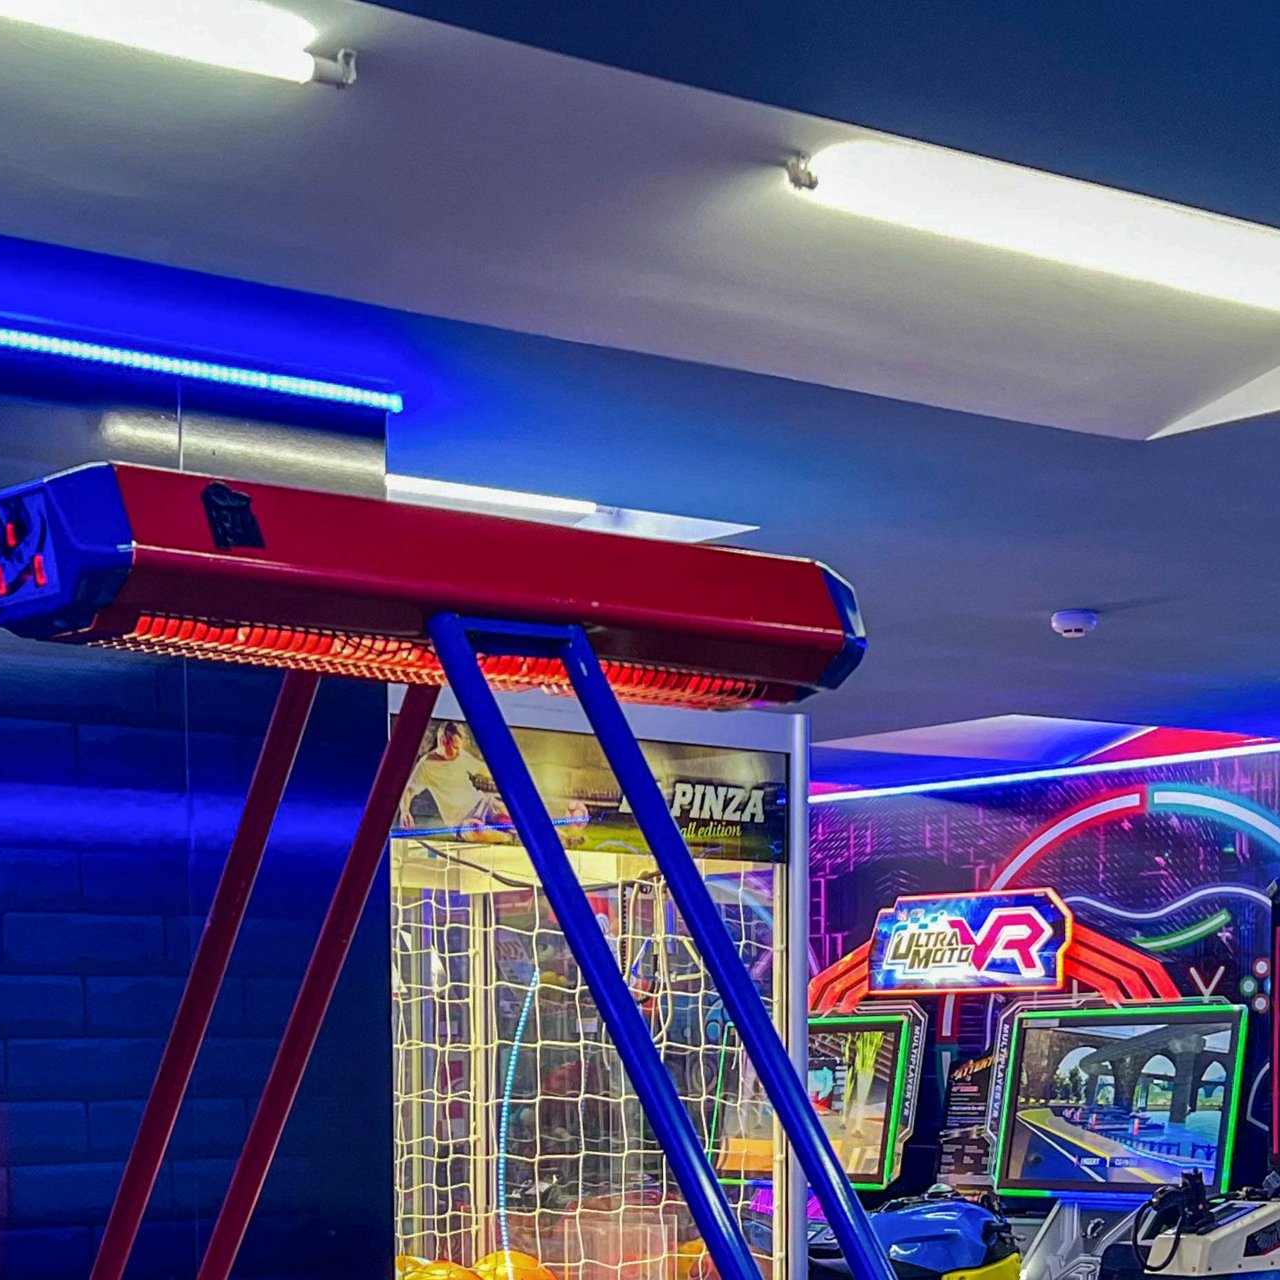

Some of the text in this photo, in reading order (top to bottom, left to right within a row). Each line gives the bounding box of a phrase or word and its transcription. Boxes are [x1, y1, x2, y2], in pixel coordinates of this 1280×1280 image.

[671, 782, 765, 823] PINZA
[699, 822, 742, 838] edition
[891, 931, 959, 960] ULTRA
[947, 912, 1046, 972] VR
[907, 946, 970, 970] MOTO
